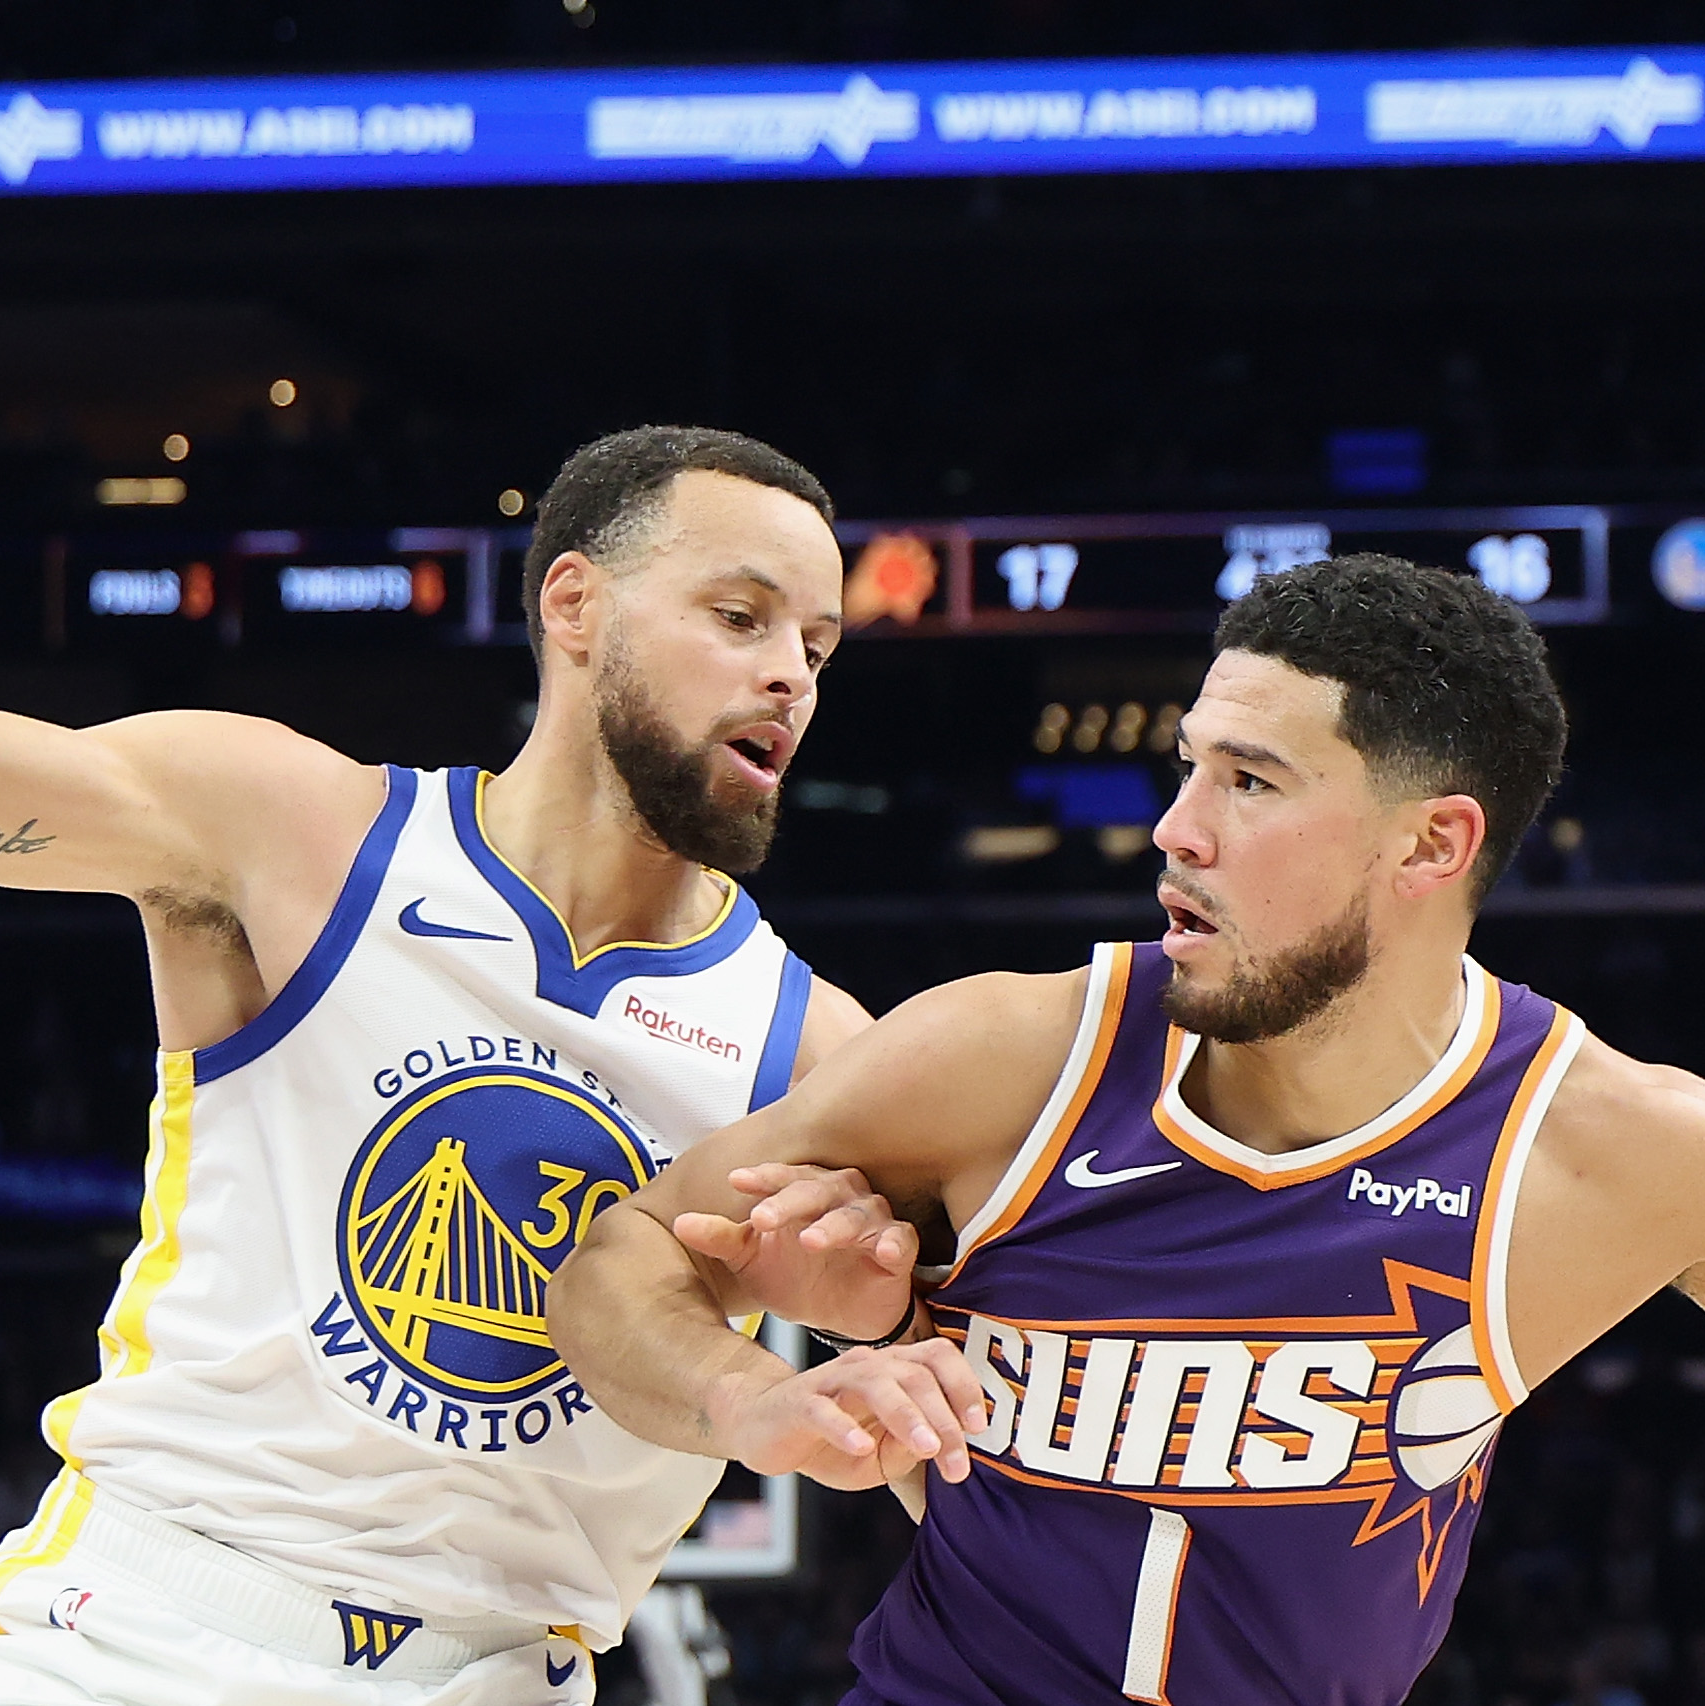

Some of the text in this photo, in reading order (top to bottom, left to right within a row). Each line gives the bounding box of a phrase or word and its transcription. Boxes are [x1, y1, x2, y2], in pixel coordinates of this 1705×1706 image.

[998, 542, 1079, 611] 17
[624, 995, 742, 1063] Rakuten
[374, 1035, 557, 1099] GOLDEN
[1348, 1168, 1472, 1218] PayPal
[310, 1292, 593, 1452] WARRIOR
[964, 1314, 1378, 1489] SUNS
[1122, 1507, 1191, 1706] 1
